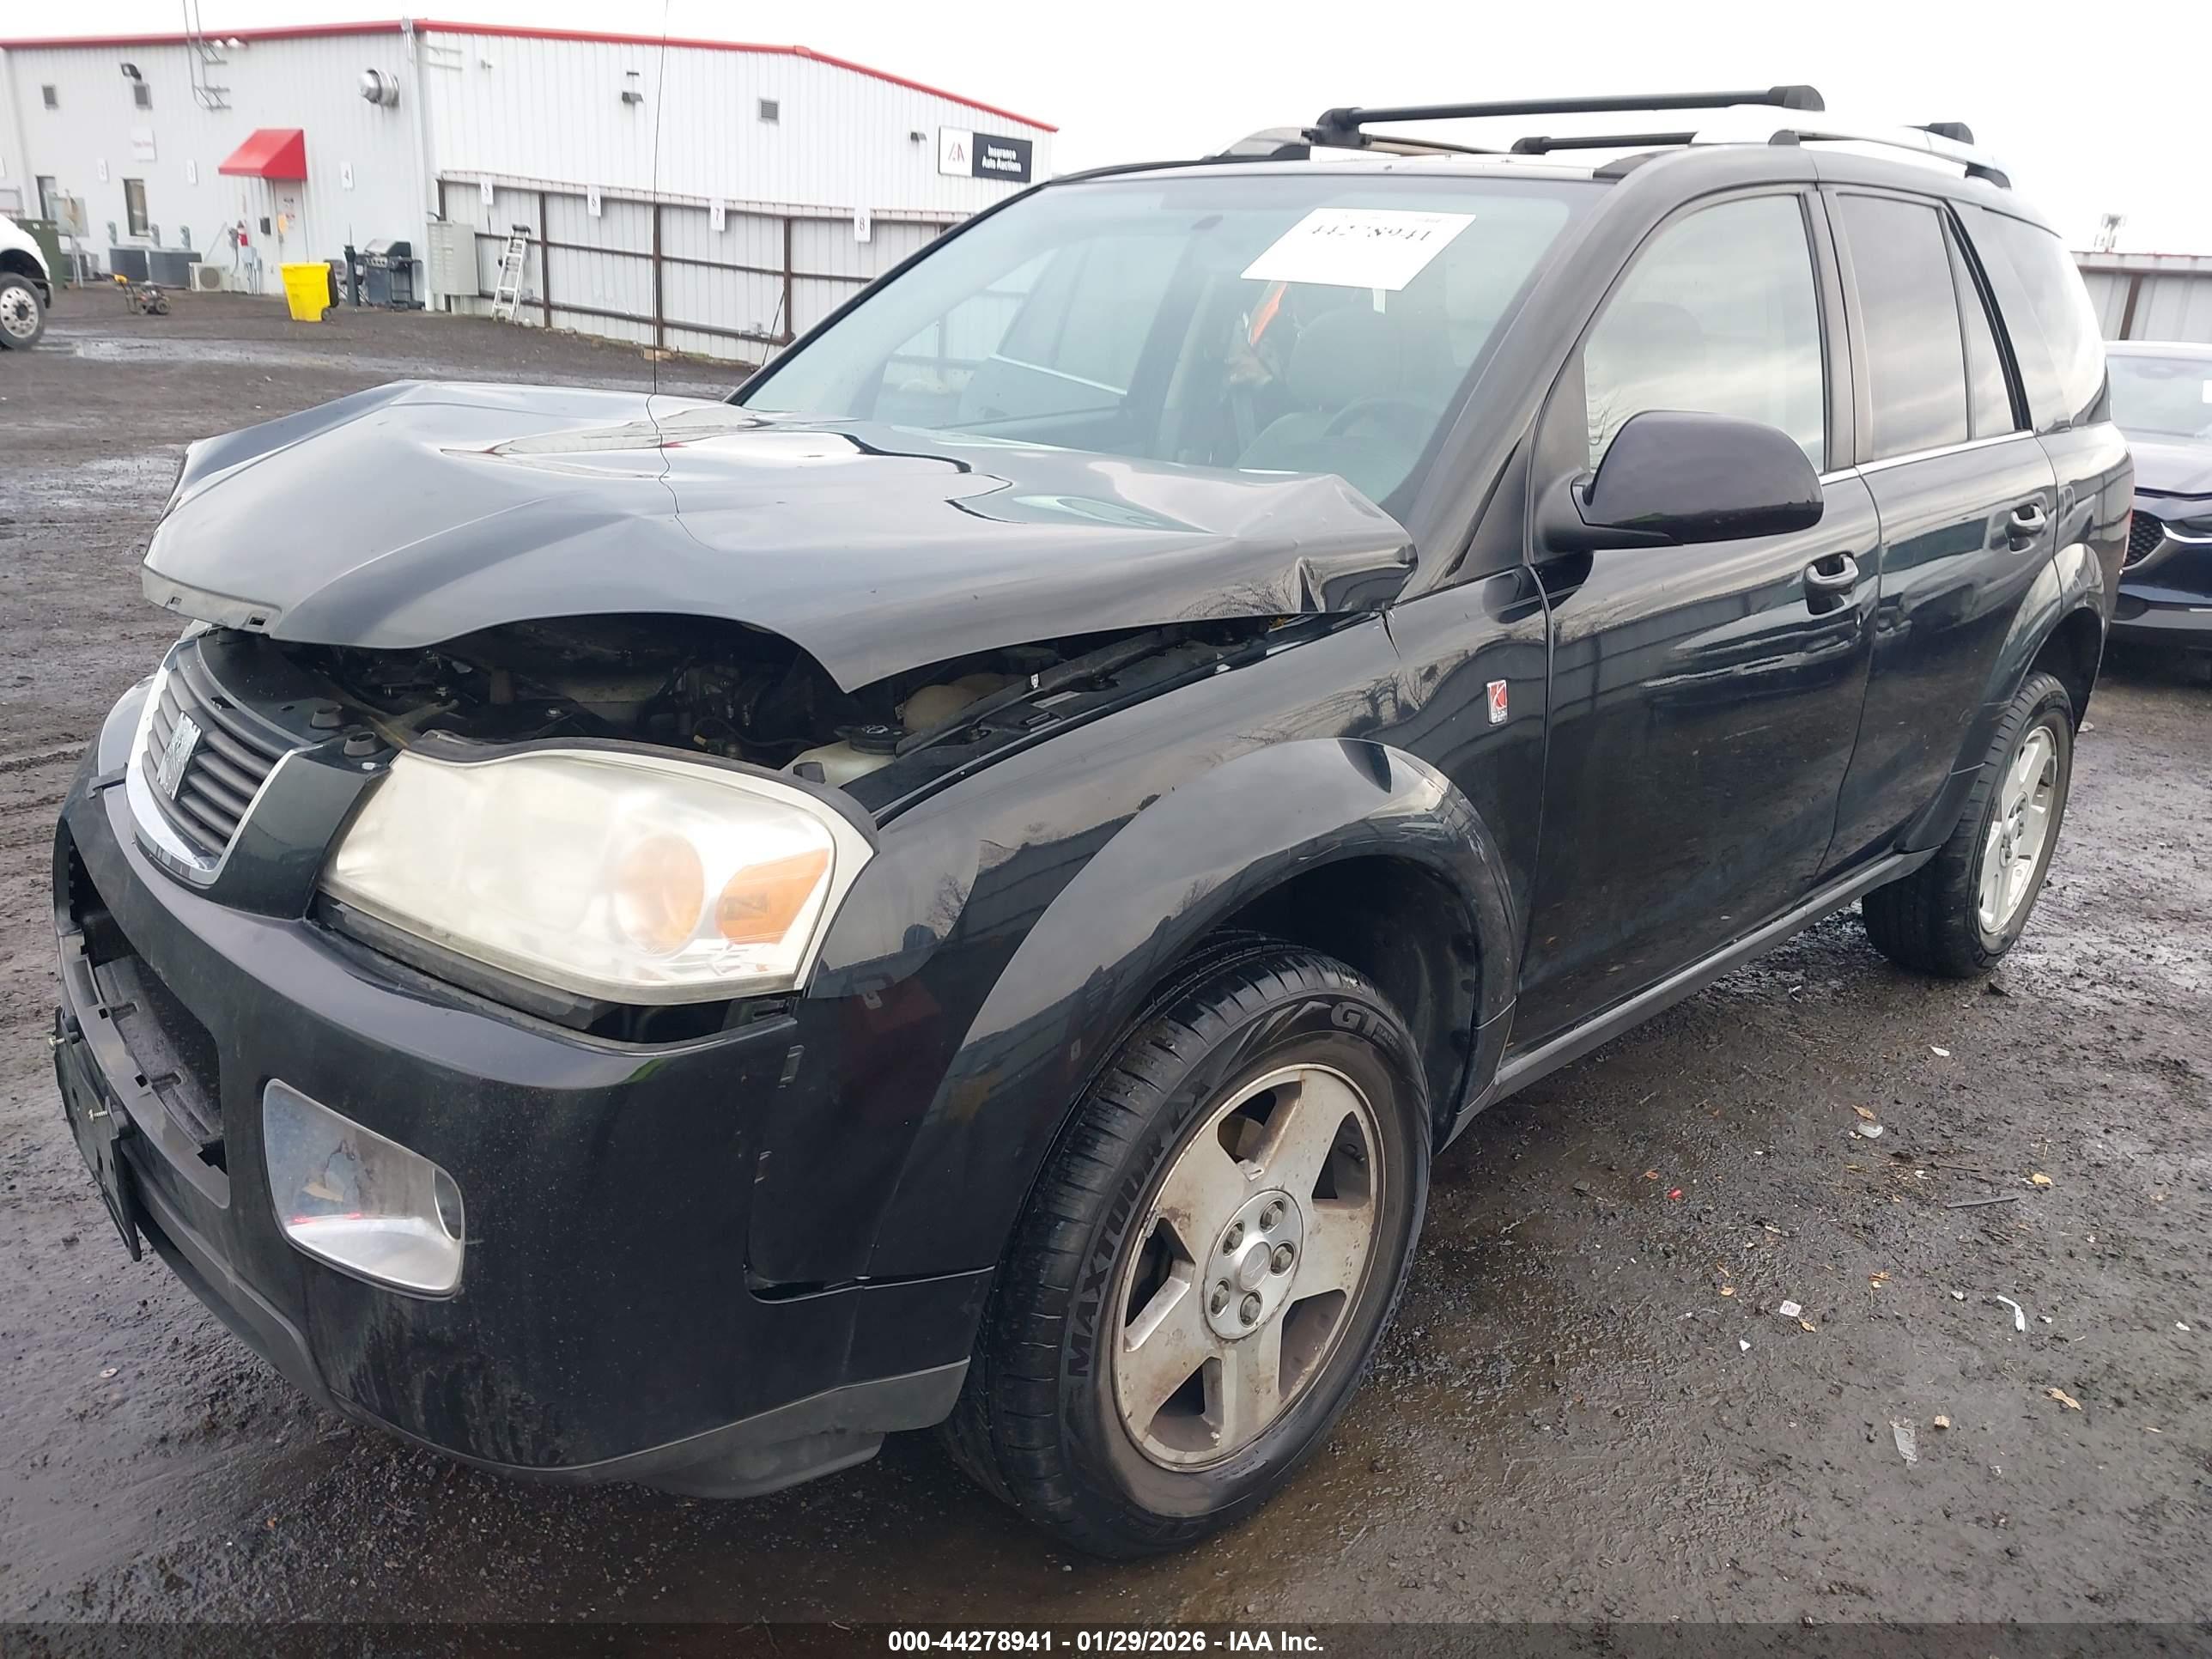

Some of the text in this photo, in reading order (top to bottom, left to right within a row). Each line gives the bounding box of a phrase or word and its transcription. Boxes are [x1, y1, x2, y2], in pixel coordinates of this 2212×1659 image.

[981, 155, 996, 170] Auto
[591, 194, 597, 208] 6
[714, 206, 720, 221] 7
[859, 216, 866, 232] 8
